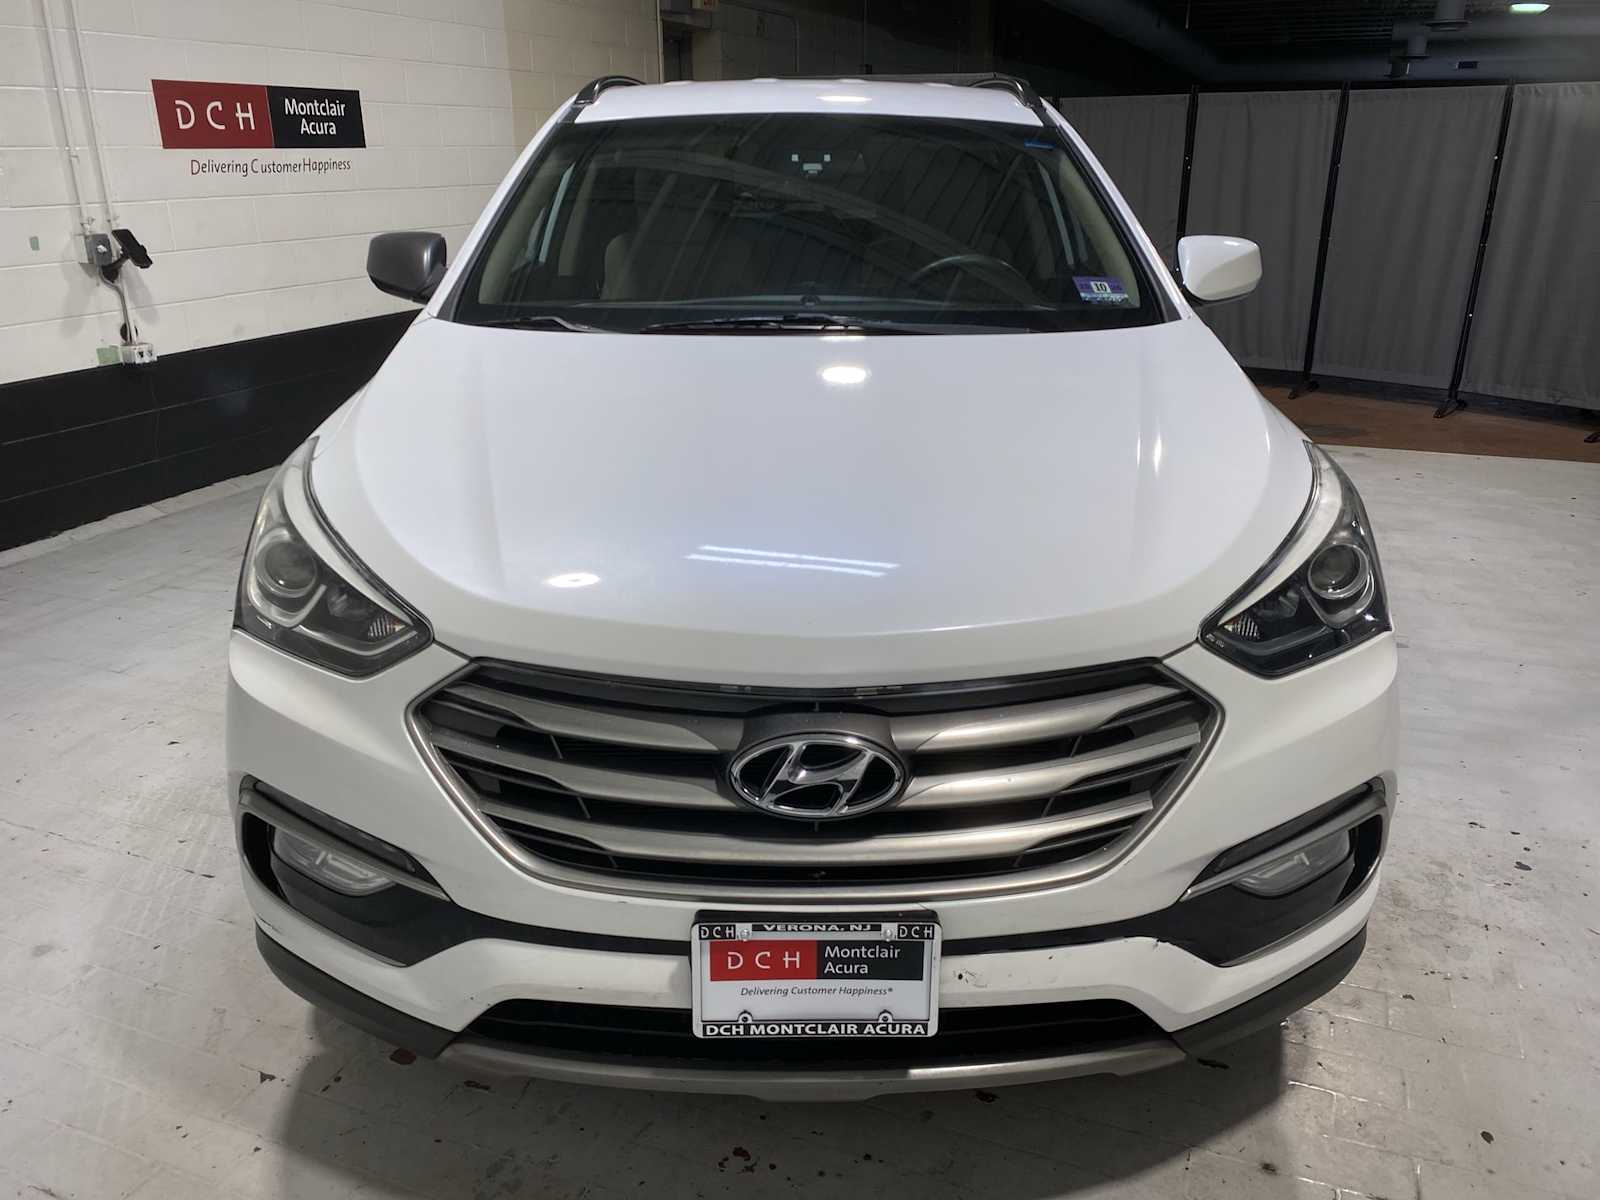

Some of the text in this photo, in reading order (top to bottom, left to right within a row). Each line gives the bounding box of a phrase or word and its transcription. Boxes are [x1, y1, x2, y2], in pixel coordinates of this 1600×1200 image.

[175, 99, 256, 130] DCH
[284, 98, 346, 117] Montclair
[300, 118, 337, 135] Acura
[190, 157, 351, 177] Delivering Customer Happiness
[700, 925, 736, 939] DCH
[899, 925, 934, 939] DCH
[824, 945, 901, 959] Montclair
[727, 951, 801, 970] DCH
[824, 962, 869, 975] Acura
[740, 986, 789, 997] Delivering
[791, 985, 837, 996] Customer
[705, 1023, 926, 1036] DCH MONTCLAIR ACURA
